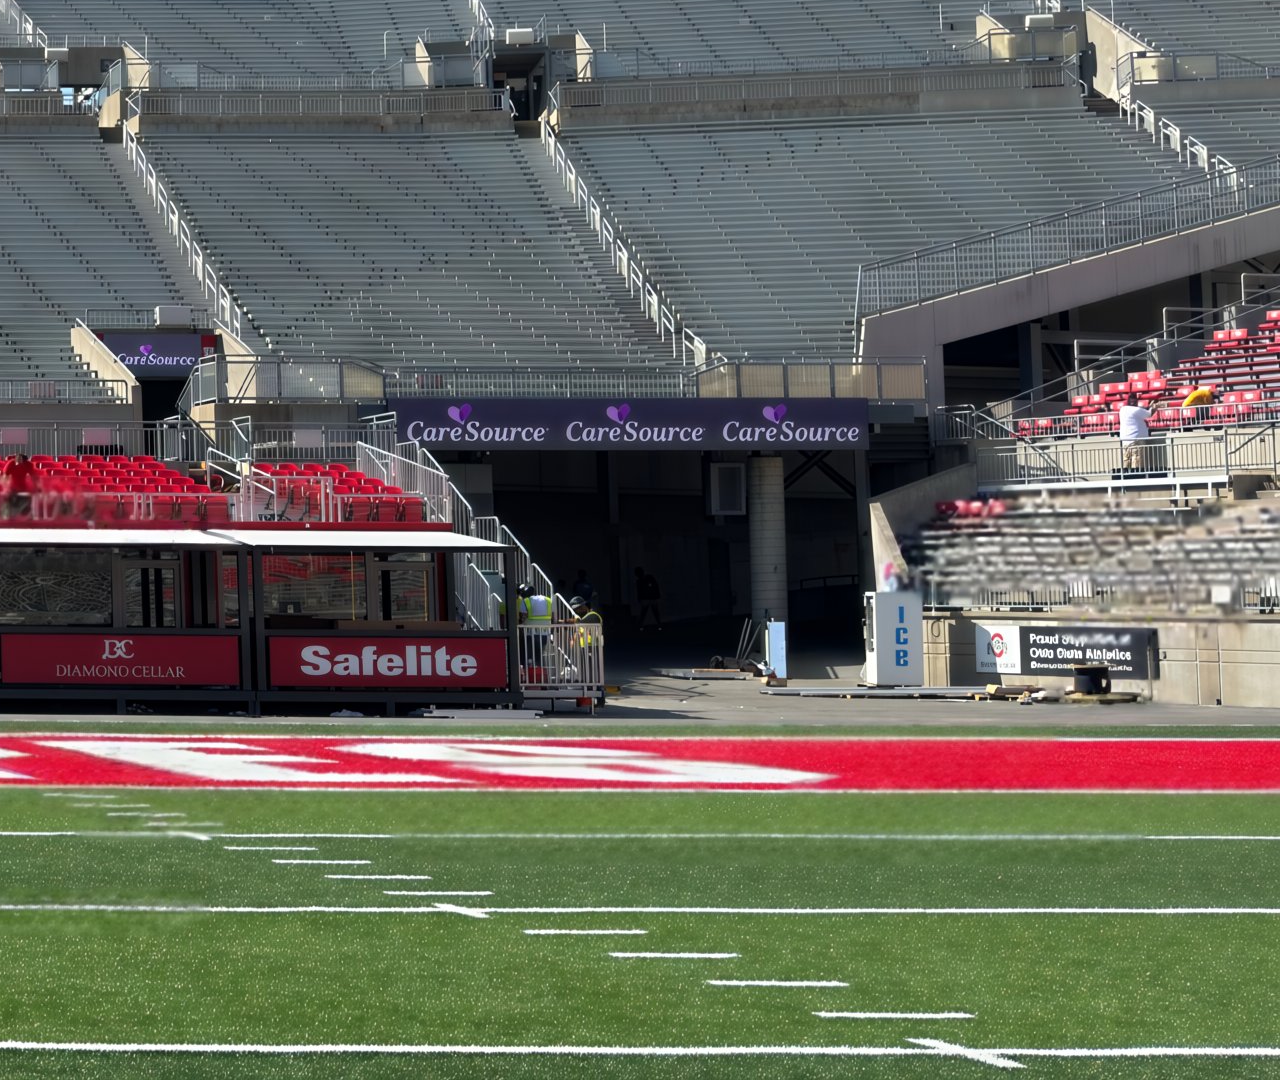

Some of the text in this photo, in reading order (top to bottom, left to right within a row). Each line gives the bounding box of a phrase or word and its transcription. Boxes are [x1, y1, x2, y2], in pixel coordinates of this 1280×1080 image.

[57, 665, 185, 678] DIAMOND CELLAR
[300, 644, 478, 678] Safelite
